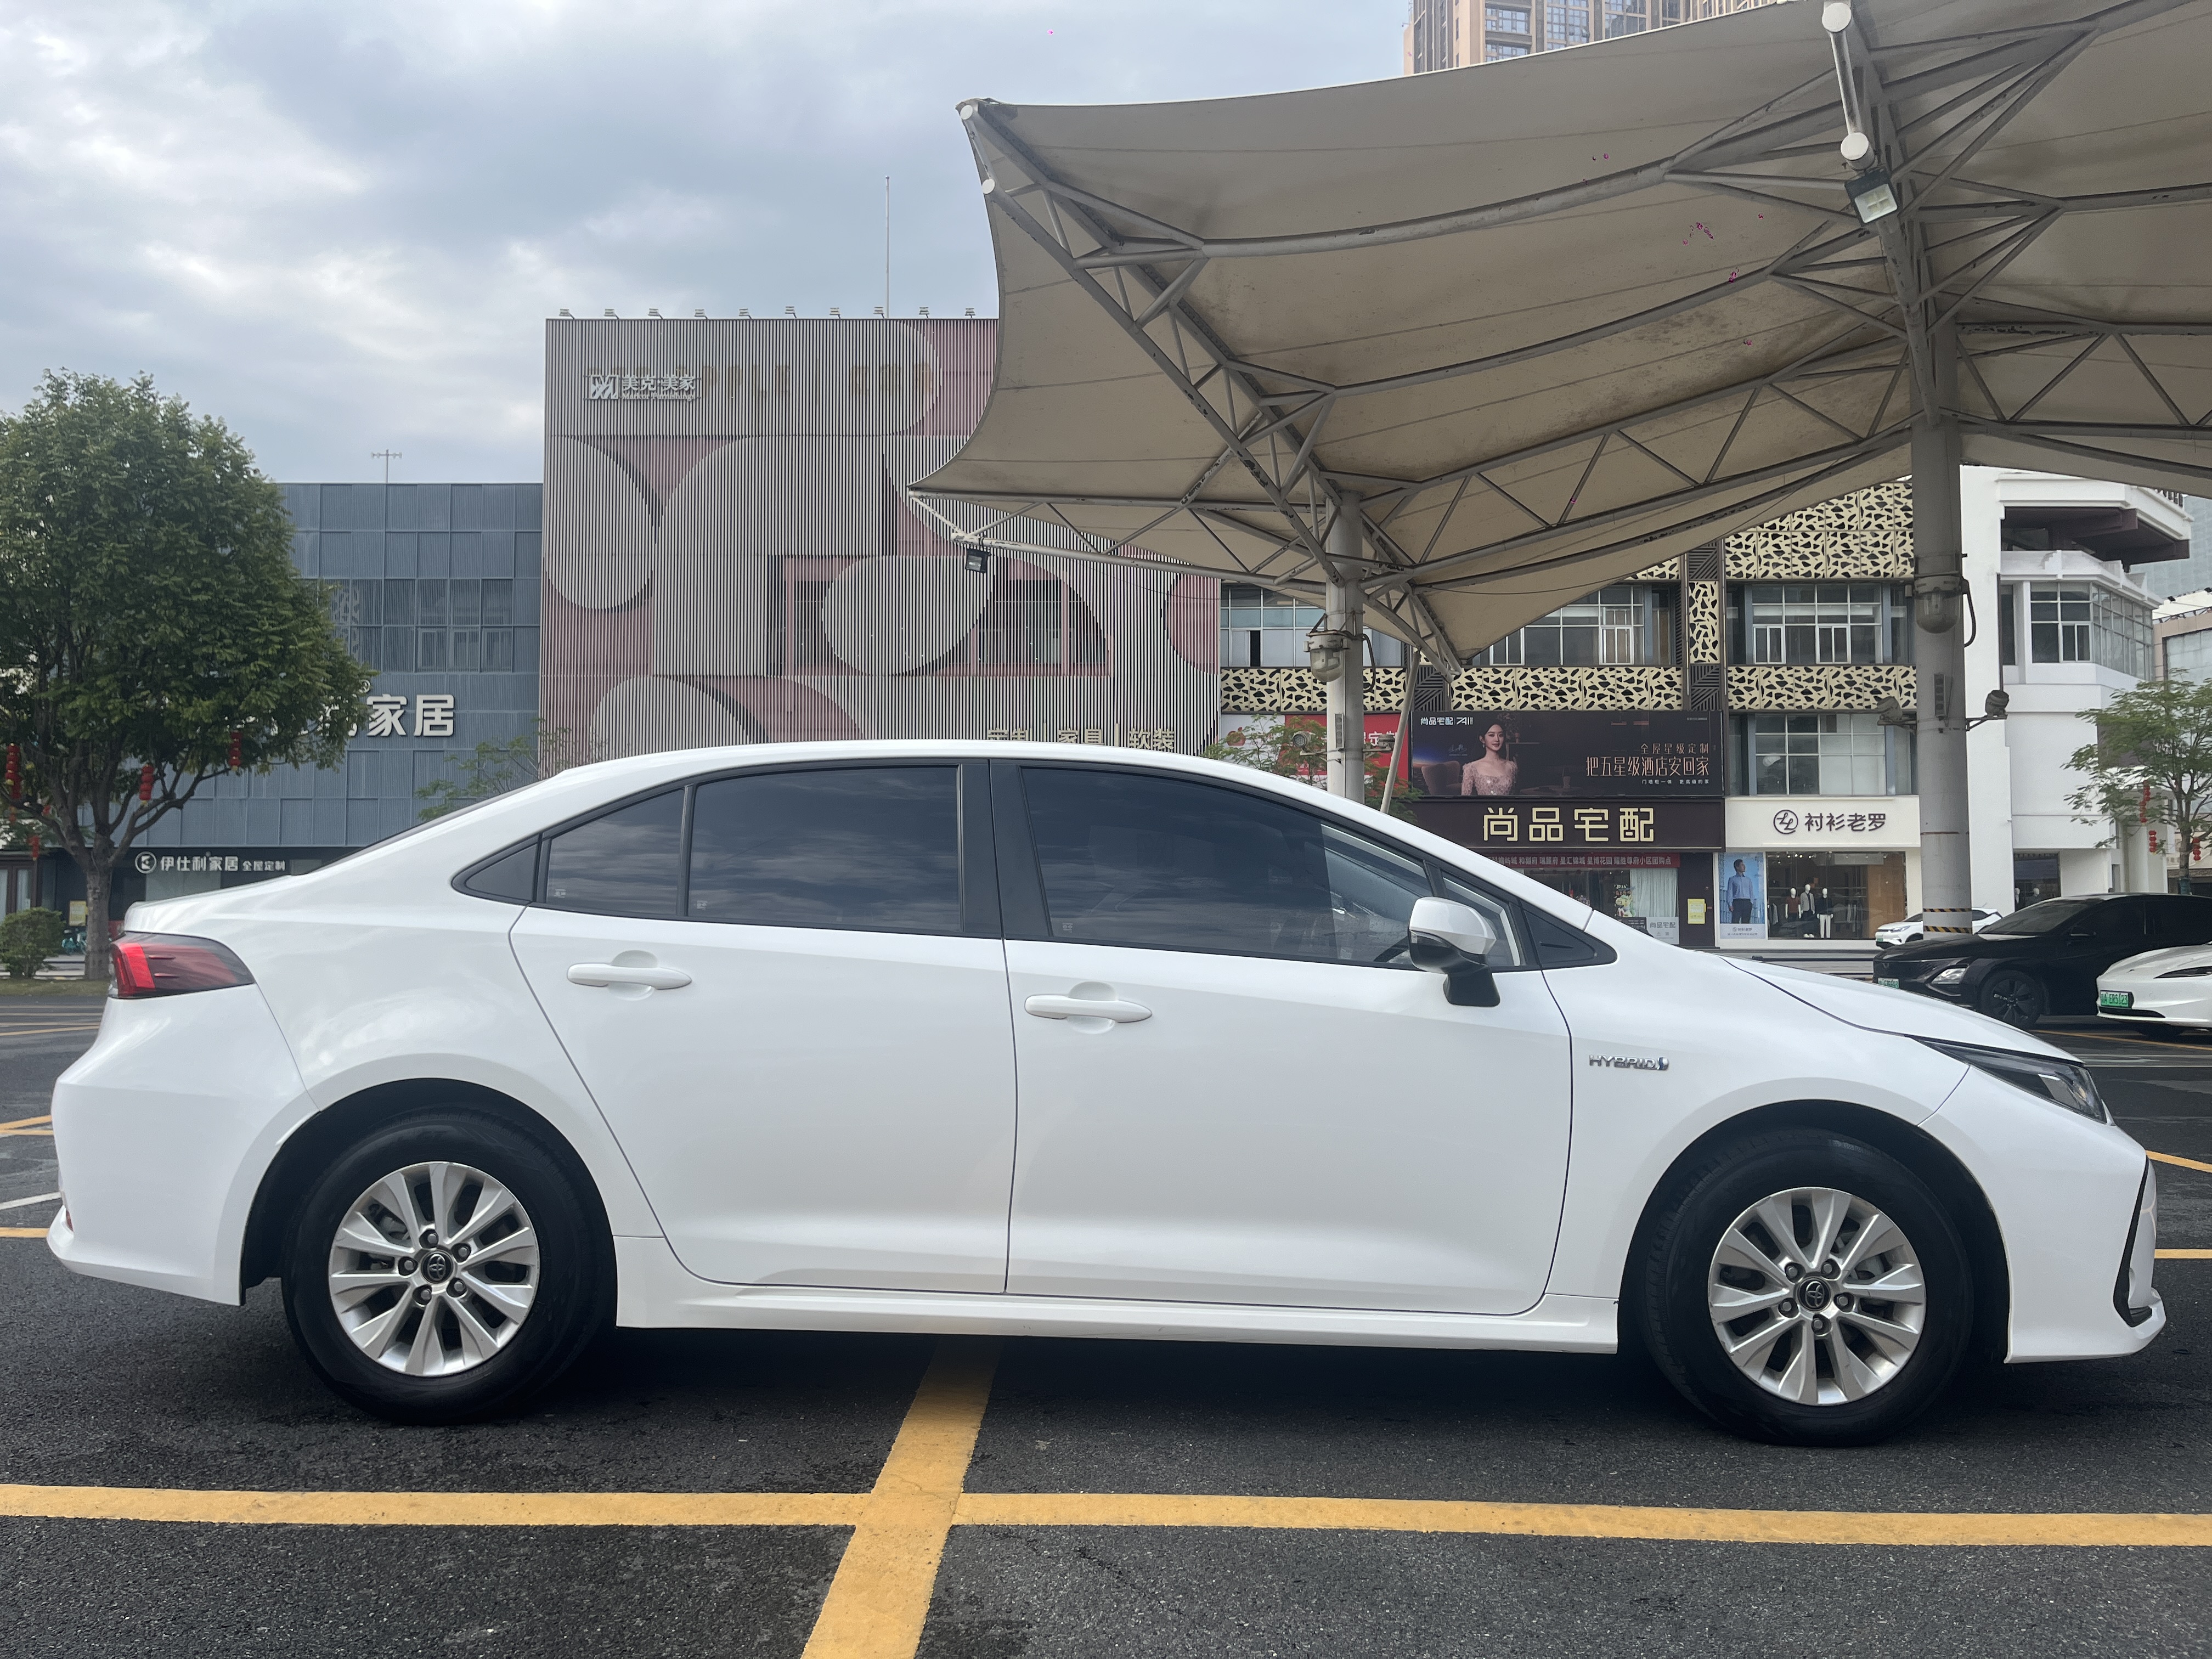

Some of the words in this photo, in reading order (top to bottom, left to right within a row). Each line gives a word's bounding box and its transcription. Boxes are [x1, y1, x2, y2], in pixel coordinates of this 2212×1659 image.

[1420, 716, 1453, 725] 尚品宅配
[1640, 742, 1709, 754] 全屋星级定制
[1585, 755, 1709, 777] 把五星级酒店安回家
[1483, 807, 1654, 842] 尚品宅配
[1804, 812, 1886, 832] 衬衫老罗
[160, 856, 239, 871] 伊仕利家居
[242, 860, 286, 872] 全屋定制
[1589, 1054, 1656, 1070] HYBRID
